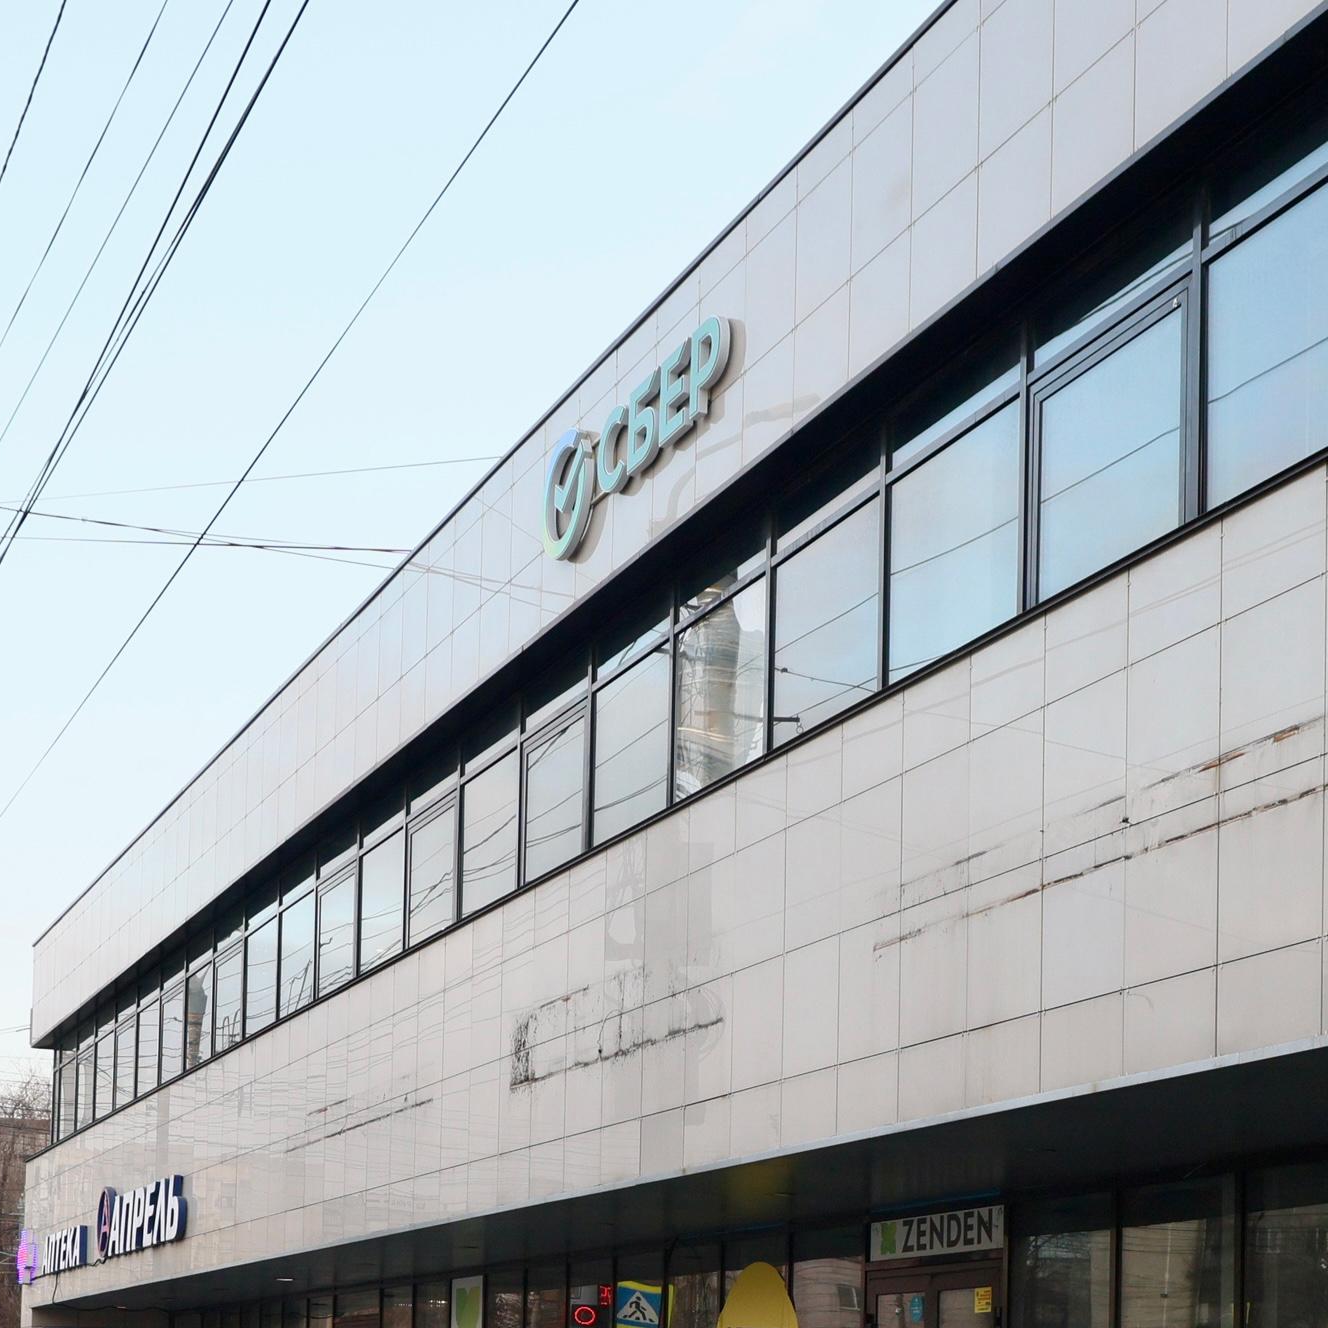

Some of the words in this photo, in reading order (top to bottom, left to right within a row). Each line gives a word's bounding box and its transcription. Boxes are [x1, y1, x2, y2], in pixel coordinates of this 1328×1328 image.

[597, 314, 732, 495] СБЕР
[107, 1175, 184, 1257] АПРЕЛЬ
[901, 1207, 993, 1253] ZENDEN
[41, 1225, 83, 1276] АПТЕКА
